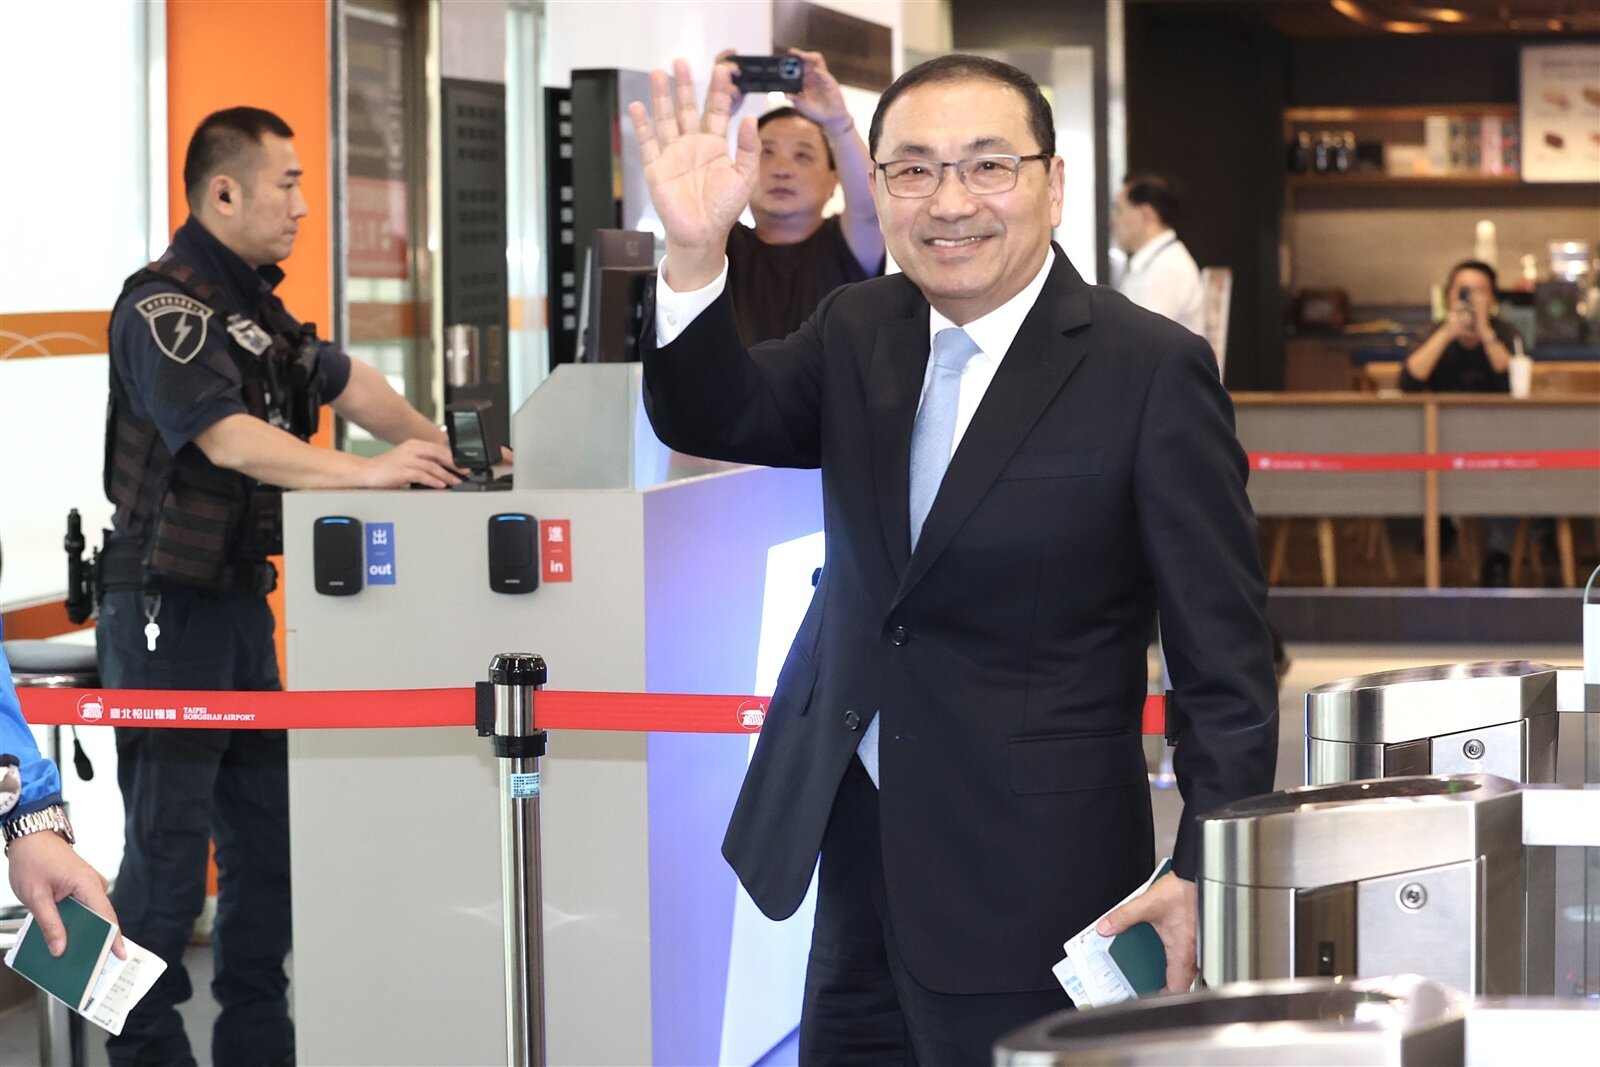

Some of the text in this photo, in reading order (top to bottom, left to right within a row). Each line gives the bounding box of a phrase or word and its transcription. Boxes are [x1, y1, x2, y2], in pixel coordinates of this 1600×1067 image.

[372, 529, 387, 545] 出
[548, 526, 563, 542] 進
[369, 563, 392, 575] out
[550, 560, 564, 573] in
[183, 713, 255, 721] SONGSHAN AIRPORT
